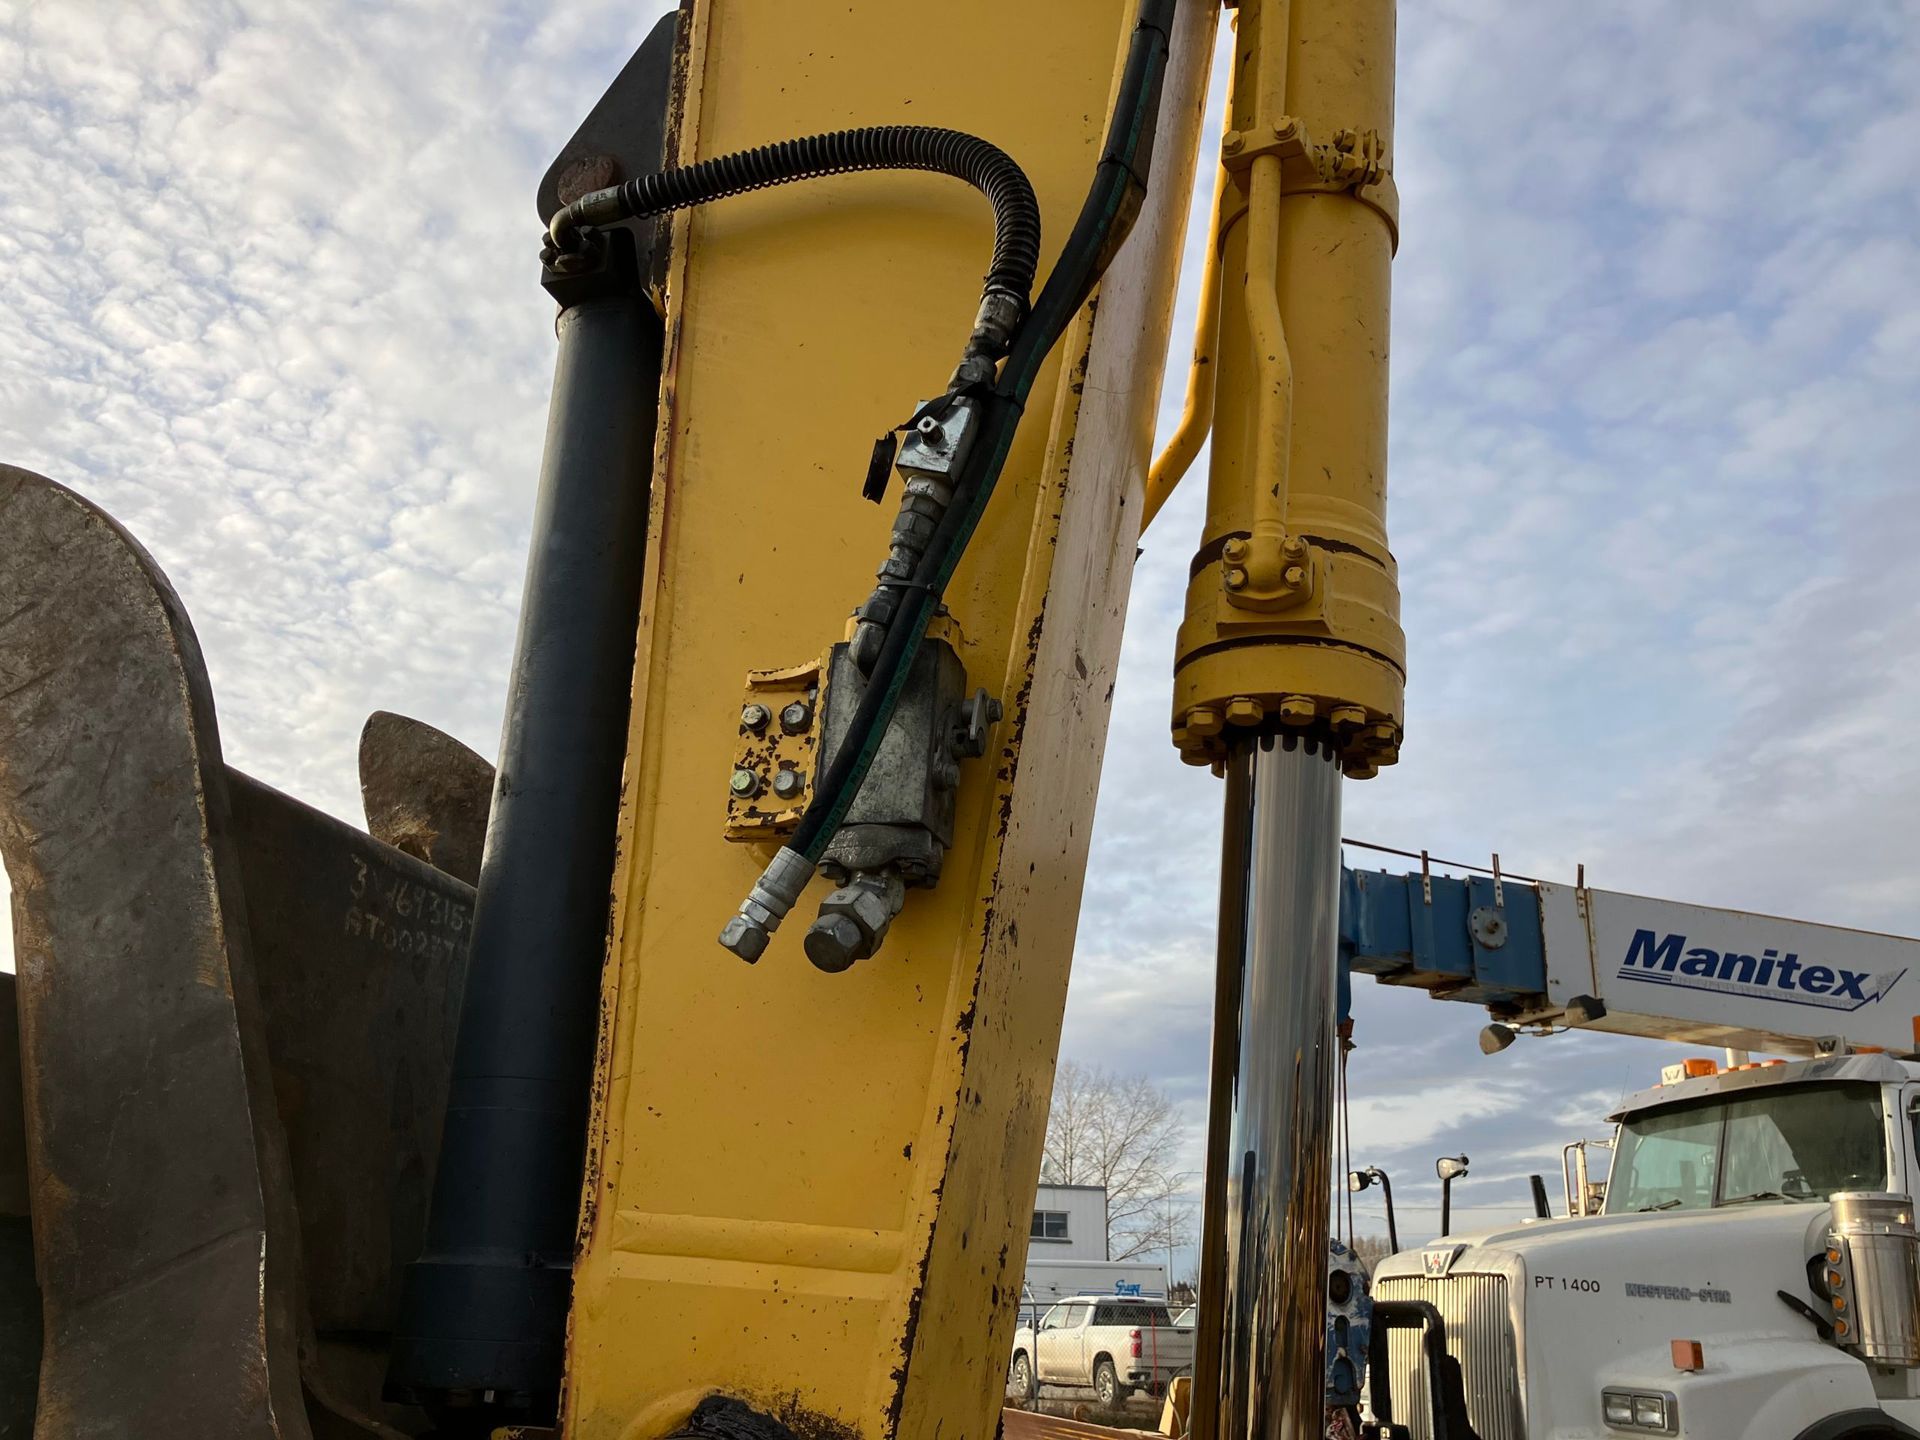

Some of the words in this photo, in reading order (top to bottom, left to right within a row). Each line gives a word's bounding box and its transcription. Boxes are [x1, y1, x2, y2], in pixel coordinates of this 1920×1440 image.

[1624, 929, 1871, 1000] Manitex
[1534, 1276, 1554, 1289] PT
[1562, 1278, 1600, 1293] 1400
